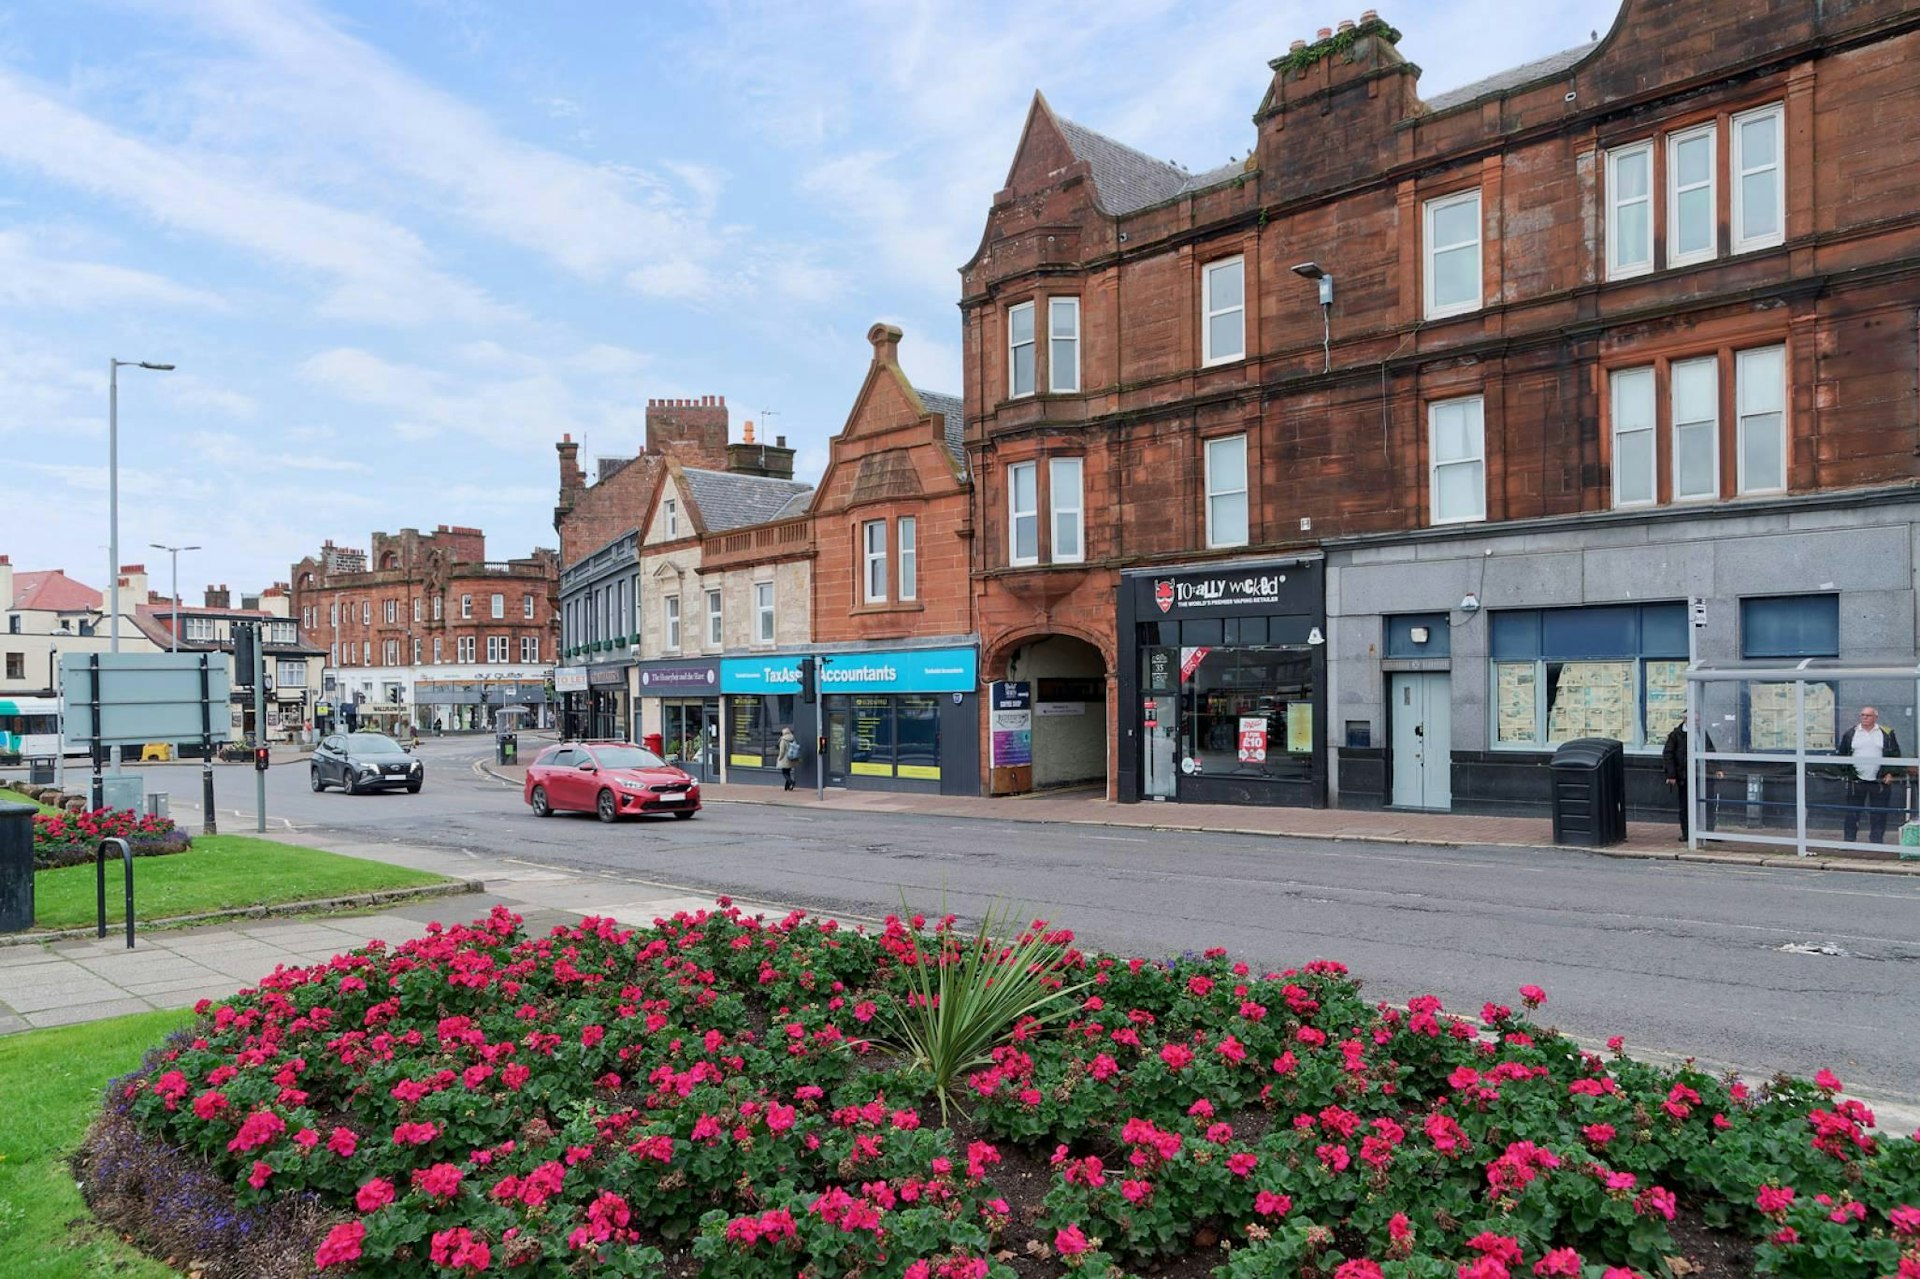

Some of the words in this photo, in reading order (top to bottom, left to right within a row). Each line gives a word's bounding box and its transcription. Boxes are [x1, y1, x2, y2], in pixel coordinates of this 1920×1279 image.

[1155, 664, 1164, 672] 35
[764, 667, 803, 683] TaxAss
[820, 664, 896, 682] Accountants
[1243, 738, 1263, 748] £10
